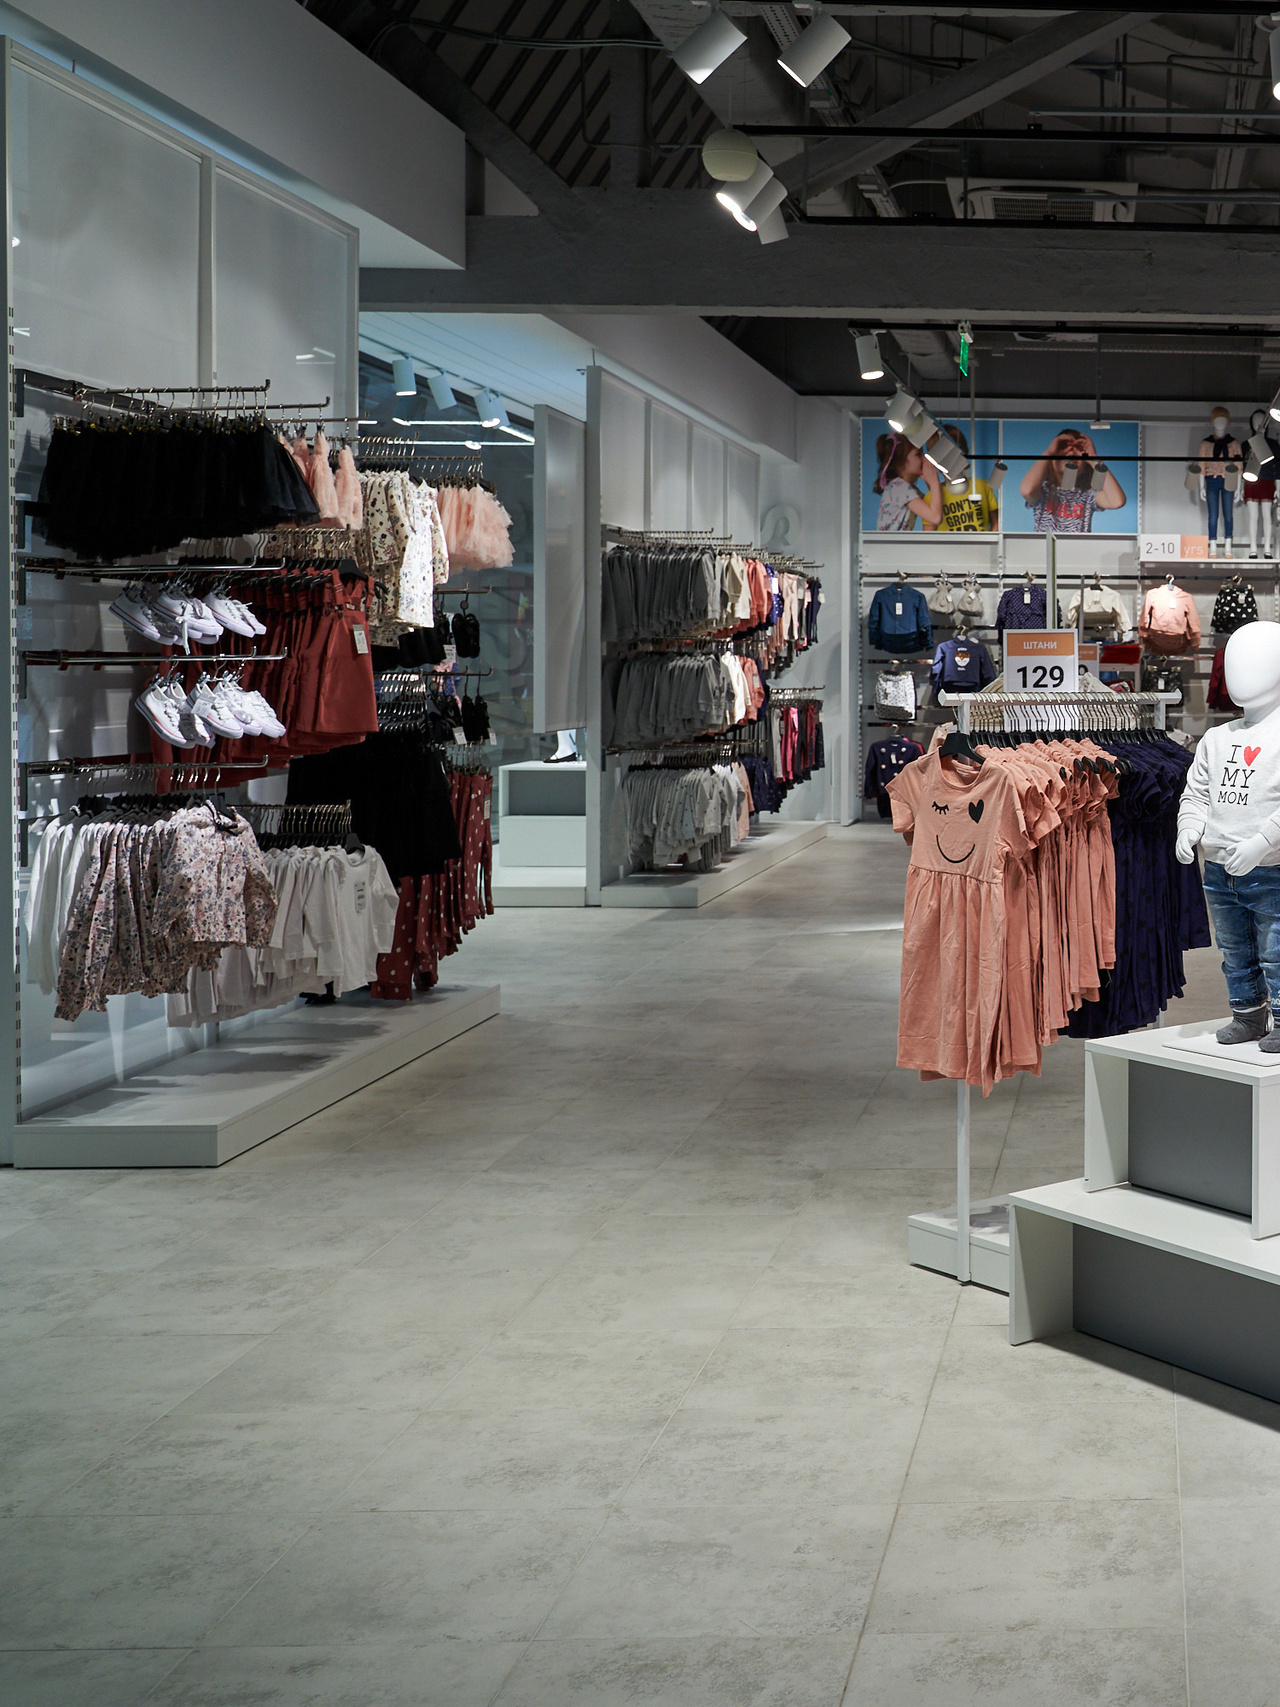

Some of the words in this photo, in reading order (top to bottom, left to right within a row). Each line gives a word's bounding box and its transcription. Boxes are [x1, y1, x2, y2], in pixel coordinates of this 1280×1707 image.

[946, 511, 974, 528] GROW
[1145, 542, 1175, 555] 2-10
[1183, 545, 1204, 558] yrs
[1023, 641, 1058, 650] ШТАНИ
[1016, 665, 1065, 689] 129
[1226, 744, 1242, 764] I
[1220, 767, 1256, 789] MY
[1217, 790, 1249, 806] MOM
